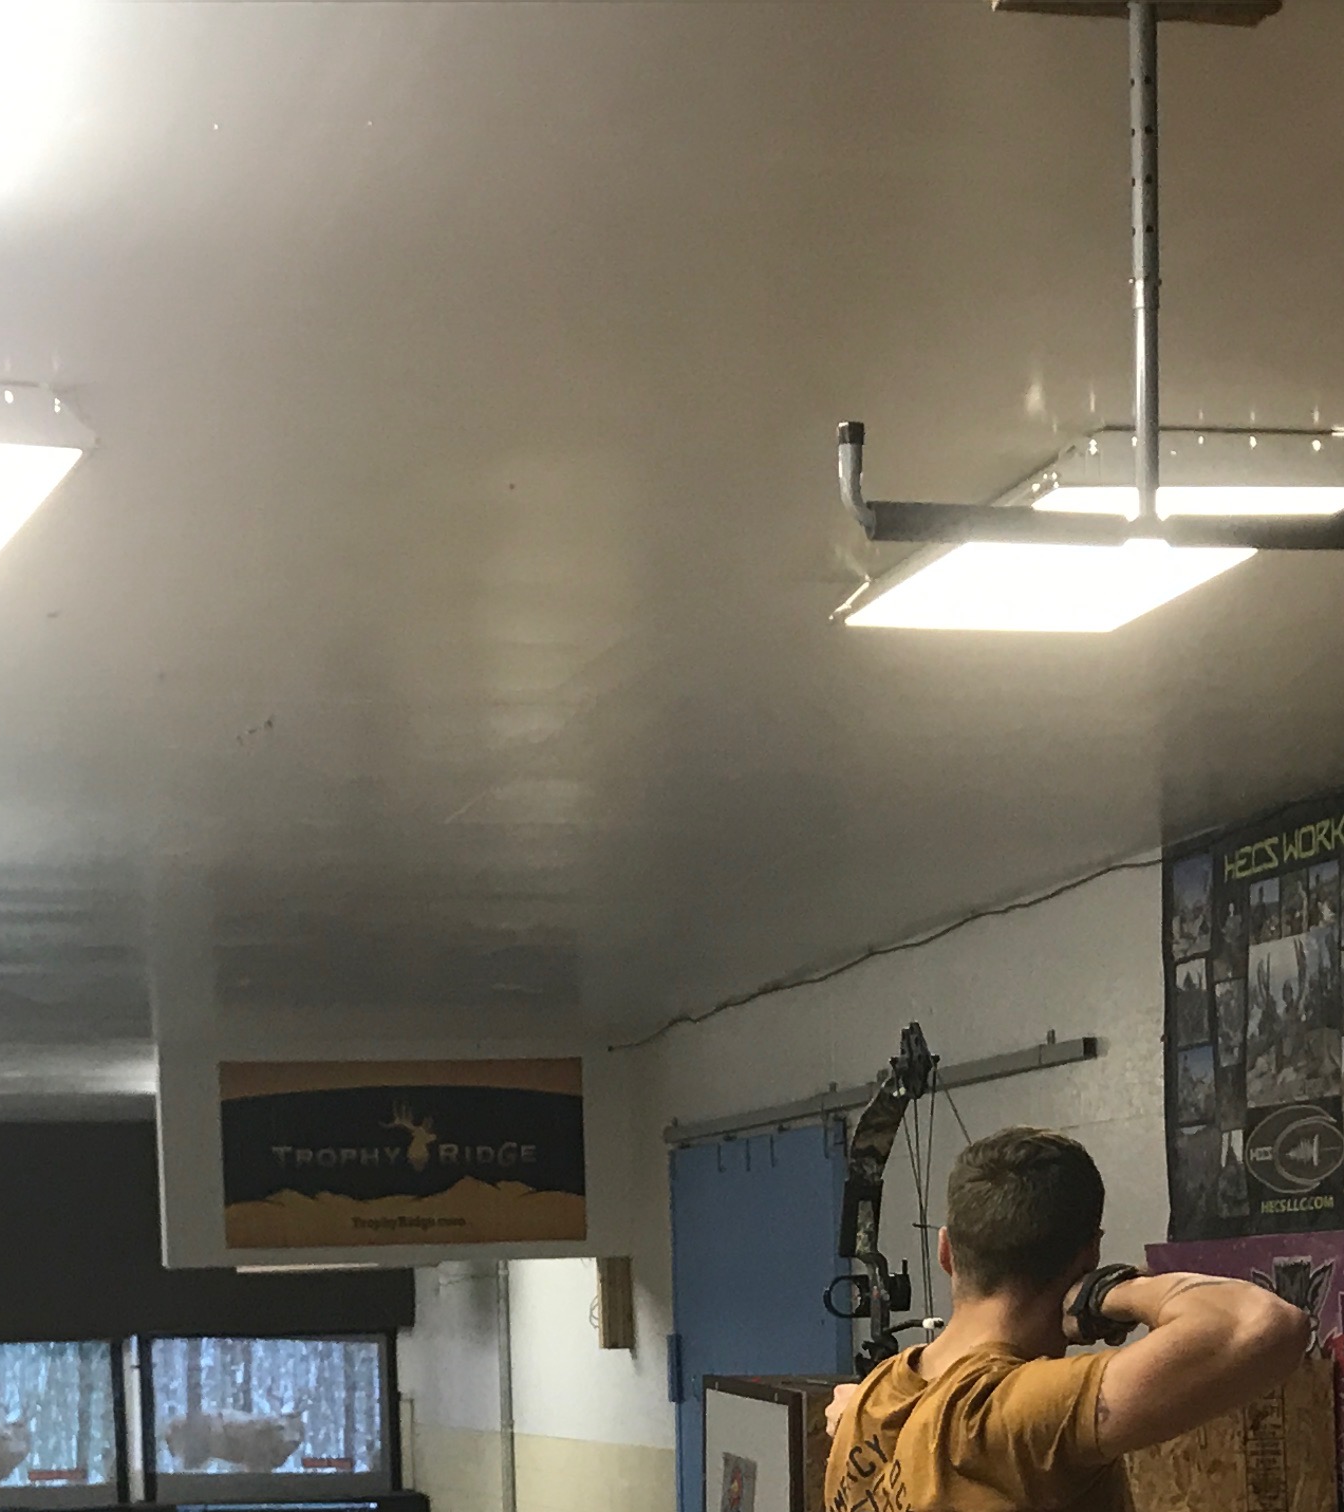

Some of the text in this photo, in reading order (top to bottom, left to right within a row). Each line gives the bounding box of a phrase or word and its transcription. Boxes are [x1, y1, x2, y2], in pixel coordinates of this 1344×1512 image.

[1223, 836, 1279, 883] HECS
[271, 1141, 537, 1169] TROPHY RIDGE
